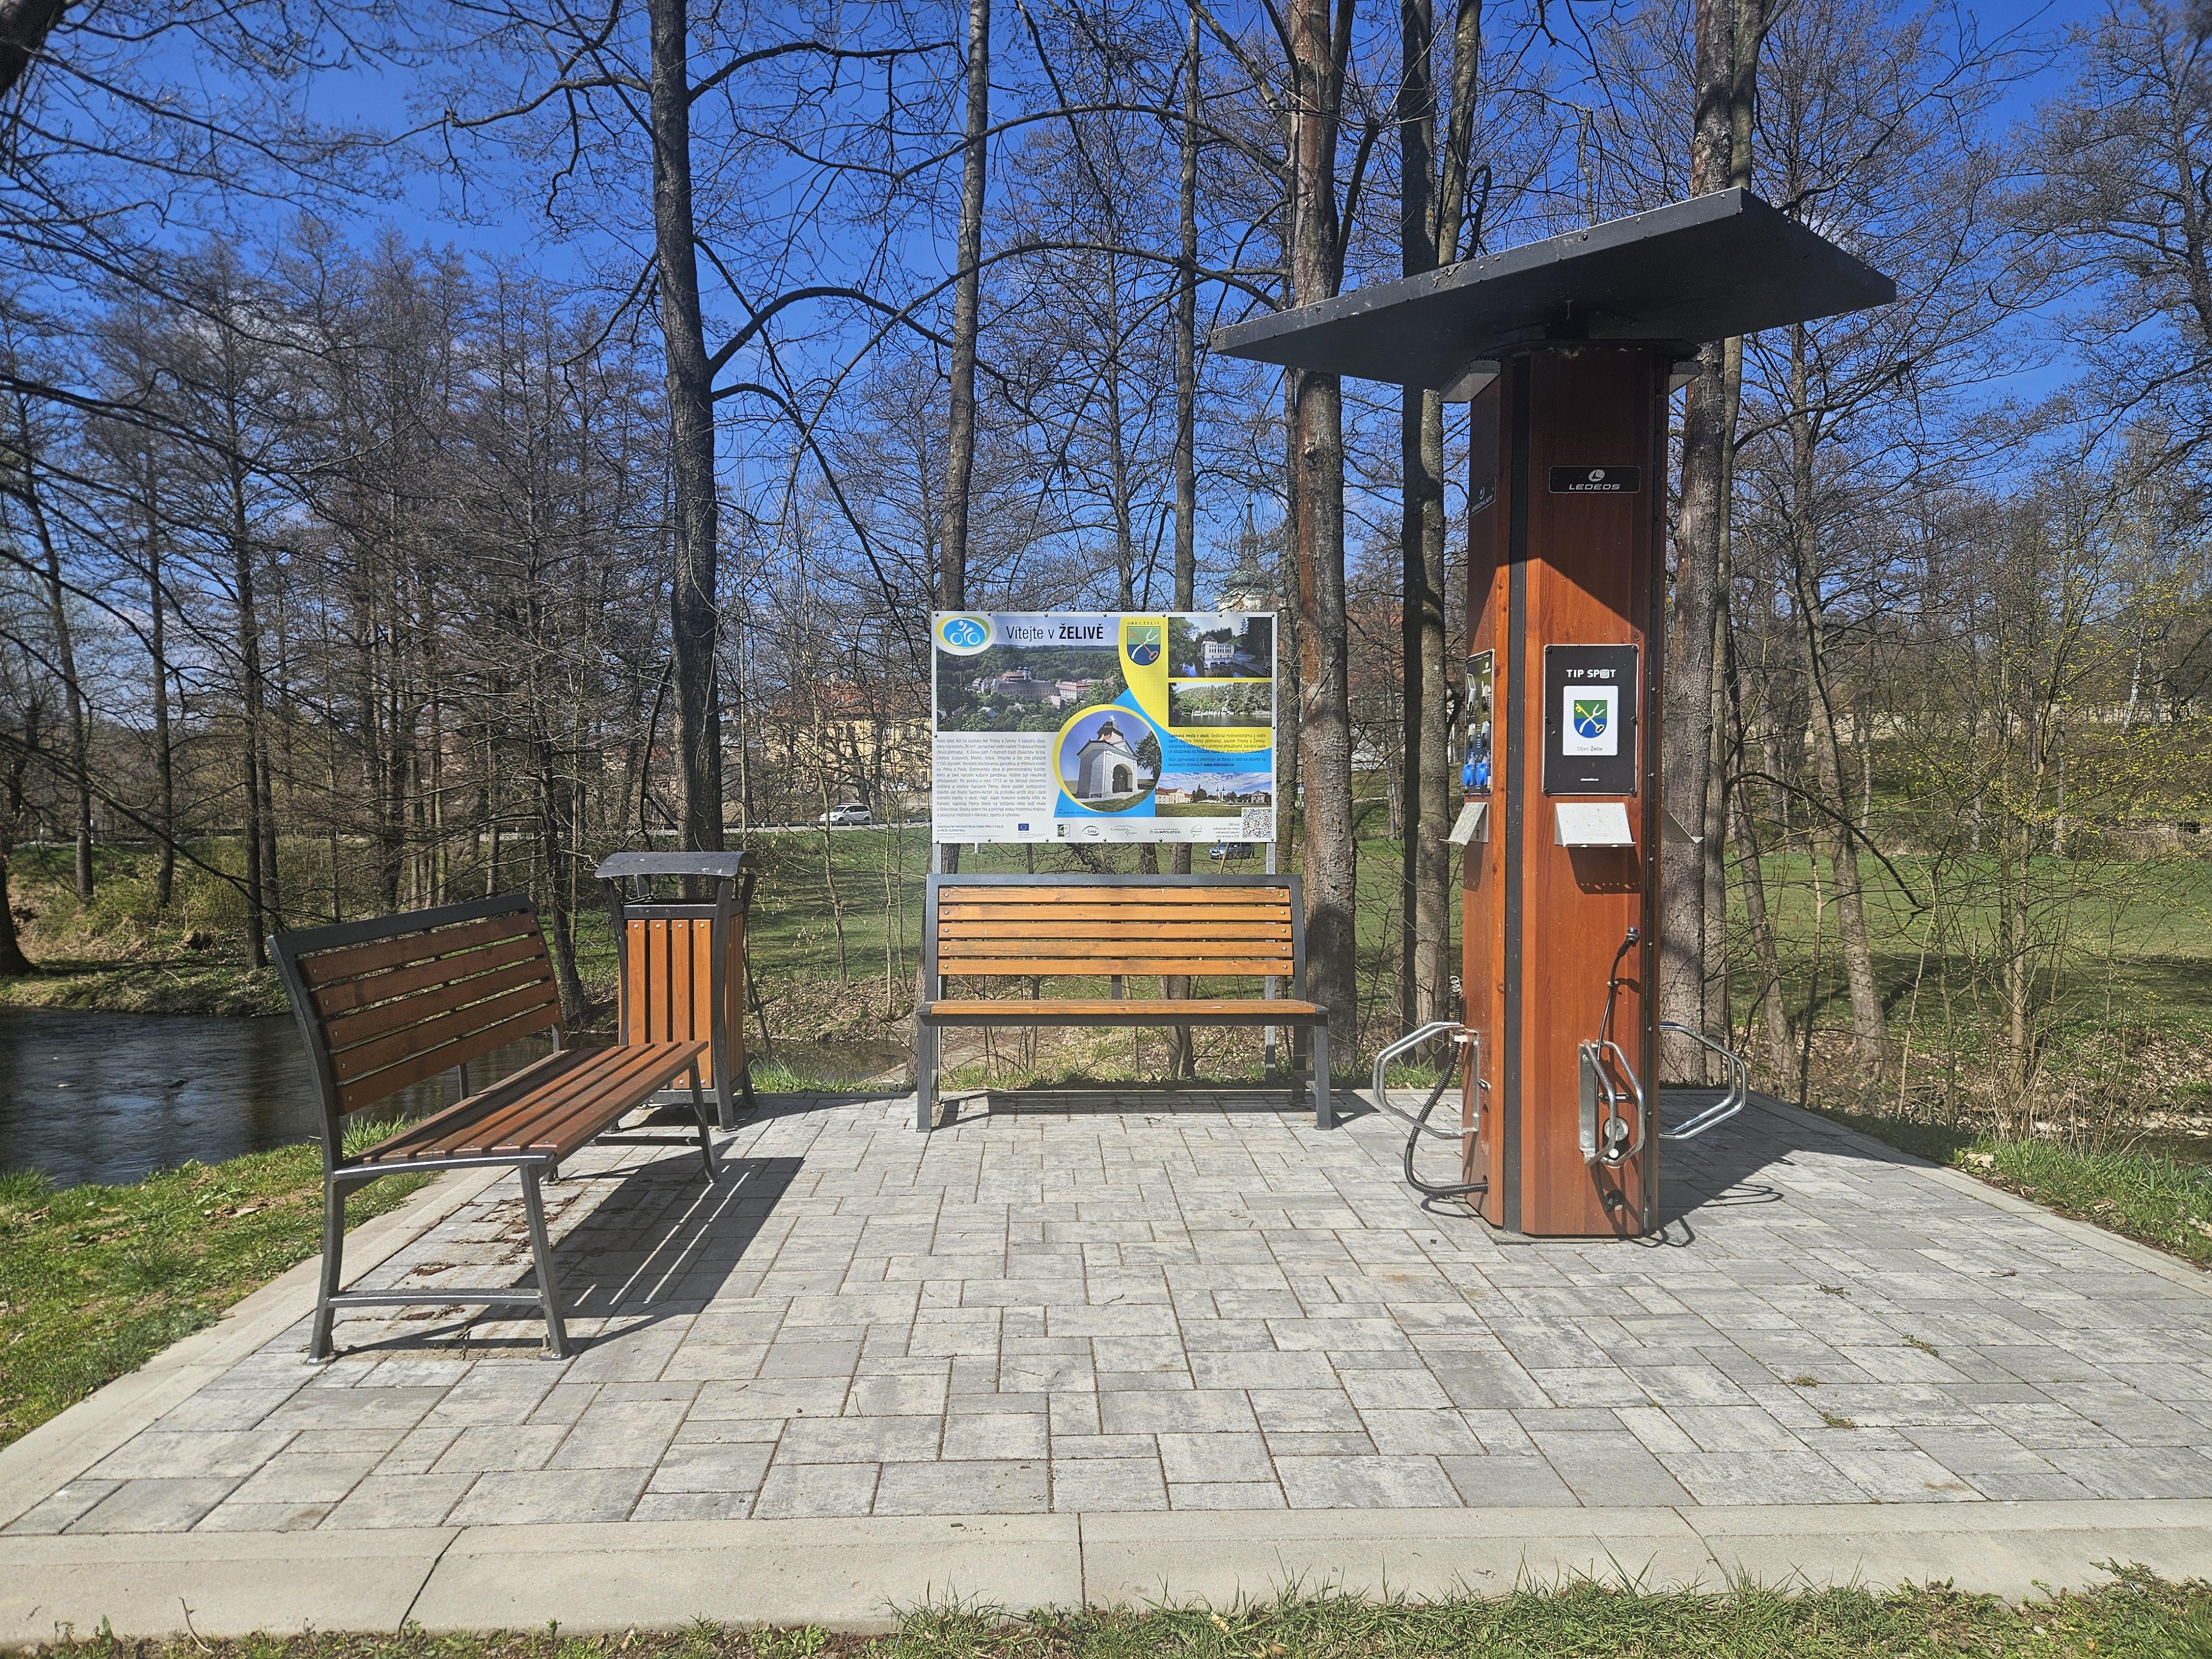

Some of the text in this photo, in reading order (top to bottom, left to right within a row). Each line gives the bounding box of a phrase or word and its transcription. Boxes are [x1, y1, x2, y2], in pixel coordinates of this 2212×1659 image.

[1006, 623, 1104, 642] Vítejte v ŽELIVĚ
[1566, 669, 1584, 678] TIP
